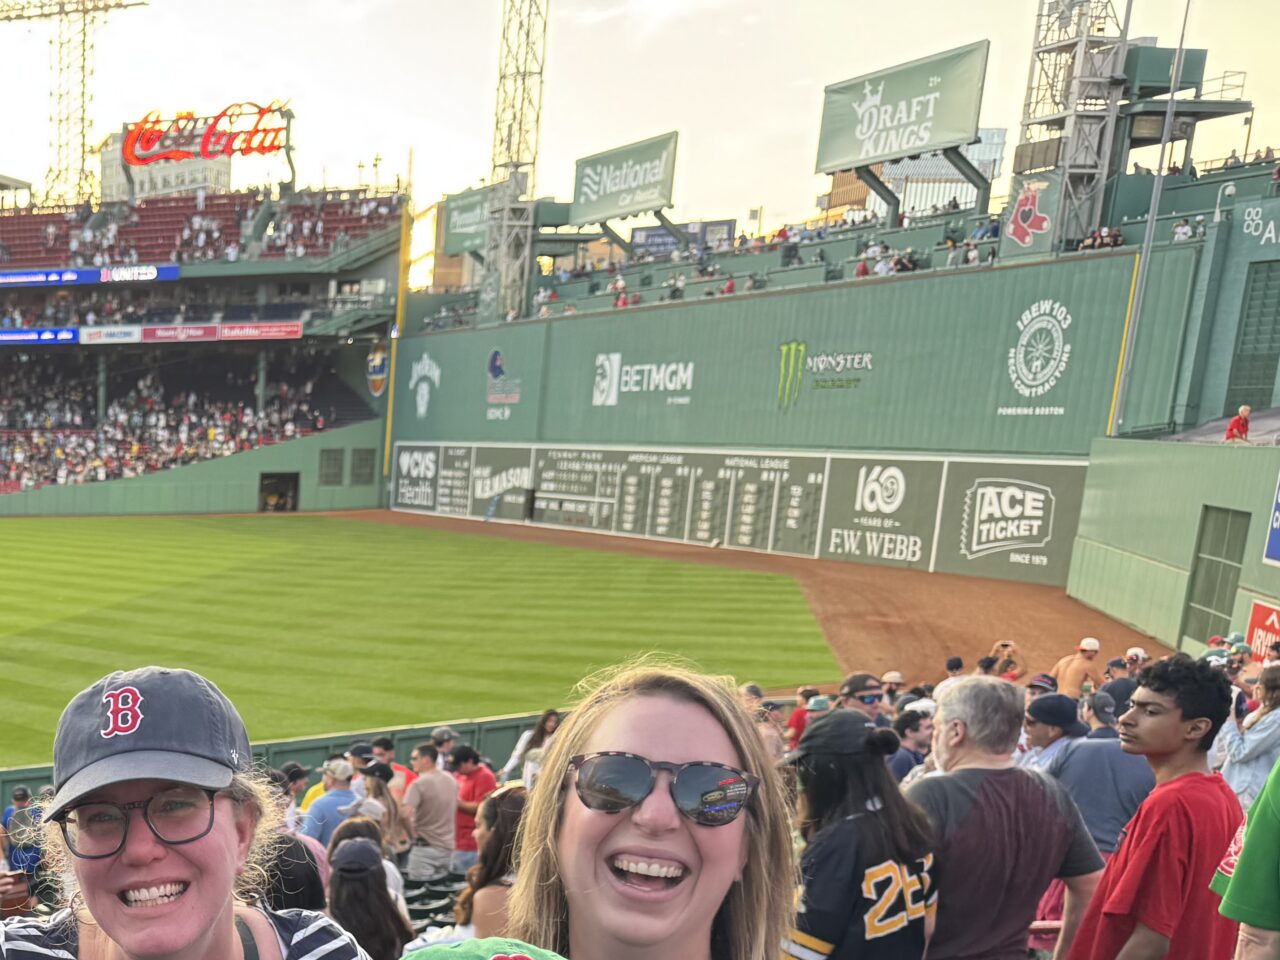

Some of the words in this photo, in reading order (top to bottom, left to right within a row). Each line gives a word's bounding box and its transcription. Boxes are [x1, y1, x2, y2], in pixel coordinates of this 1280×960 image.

[855, 92, 940, 140] DRAFT
[860, 122, 932, 158] KINGS
[599, 152, 667, 195] National
[620, 362, 694, 392] BETMGM
[806, 352, 872, 372] MONSTER
[854, 465, 906, 514] 160
[980, 486, 1045, 520] ACE
[865, 531, 922, 562] WEBB
[980, 520, 1042, 542] TICKET
[1251, 626, 1280, 656] IRV
[101, 686, 144, 738] B
